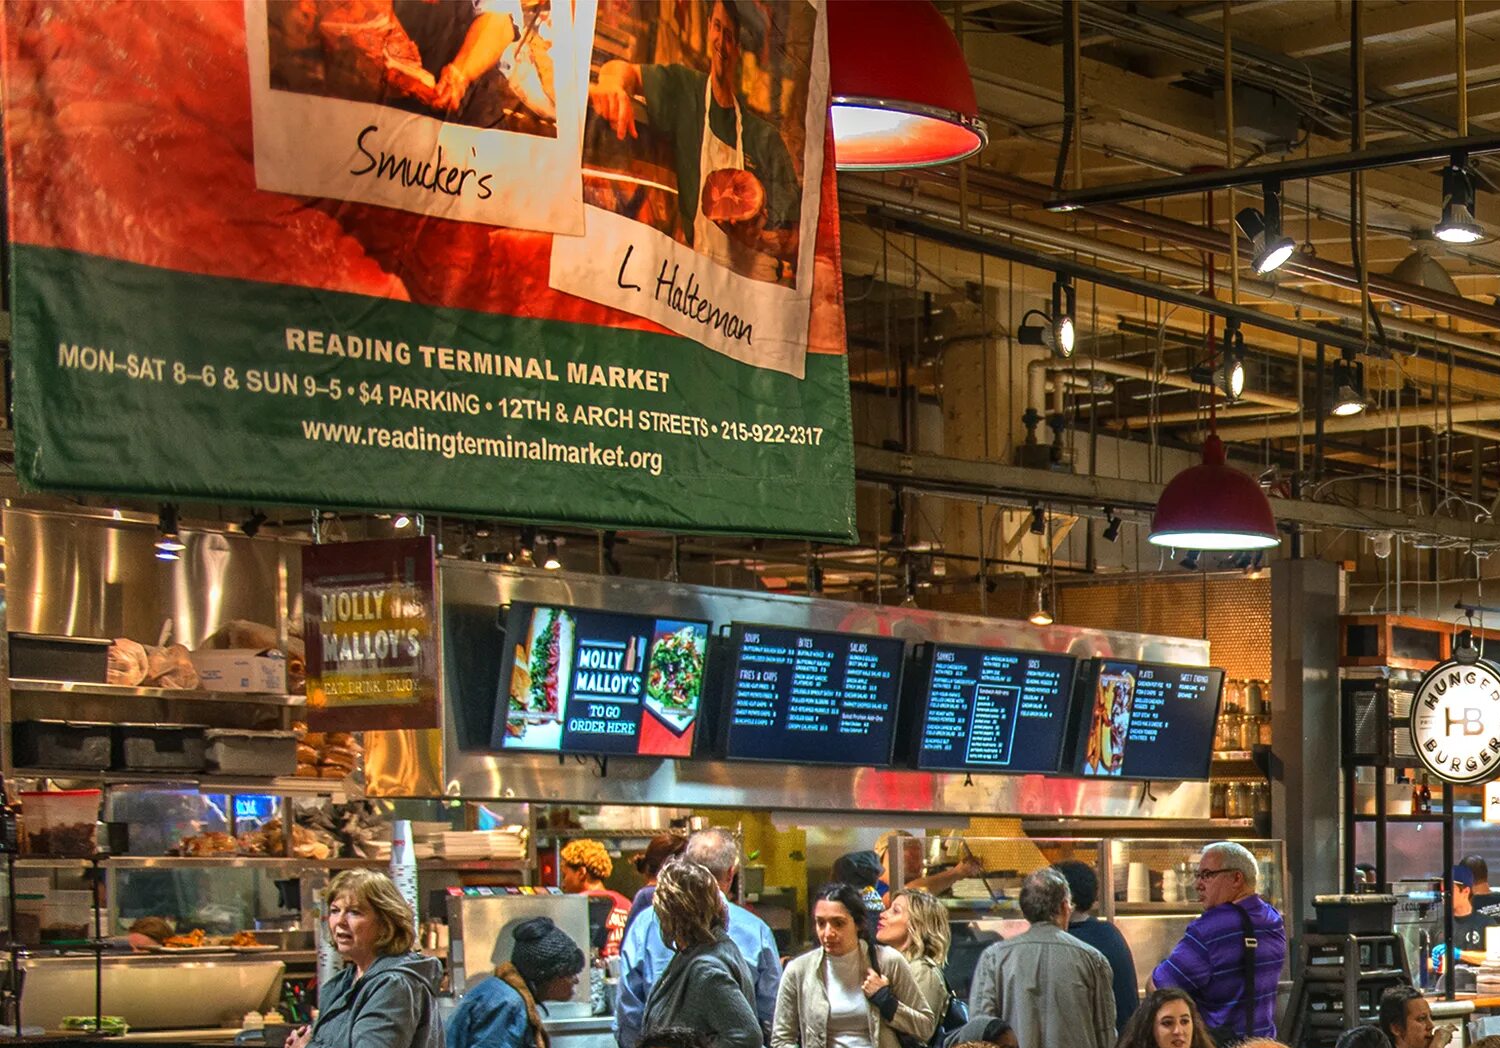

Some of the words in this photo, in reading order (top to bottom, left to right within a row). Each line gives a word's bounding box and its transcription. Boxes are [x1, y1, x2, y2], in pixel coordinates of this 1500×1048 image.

[350, 125, 493, 200] Smucker's
[656, 259, 753, 345] Halteman
[286, 328, 412, 366] READING
[419, 346, 559, 382] TERMINAL
[568, 363, 670, 393] MARKET
[223, 367, 239, 390] &
[246, 370, 298, 396] SUN
[359, 381, 383, 406] $4
[389, 385, 480, 415] PARKING
[499, 398, 550, 422] 12TH
[556, 401, 568, 423] &
[573, 405, 633, 429] ARCH
[639, 411, 708, 438] STREETS
[721, 421, 823, 446] 215-922-2317
[302, 420, 663, 475] www.readingterminalmarket.org
[321, 590, 385, 622] MOLLY
[323, 628, 421, 661] MALLOY'S
[579, 648, 624, 671] MOLLY
[575, 672, 641, 694] MALLOY'S
[569, 719, 604, 732] ORDER
[606, 722, 636, 735] HERE
[590, 705, 604, 717] TO
[606, 705, 621, 718] GO
[1445, 707, 1485, 737] HB
